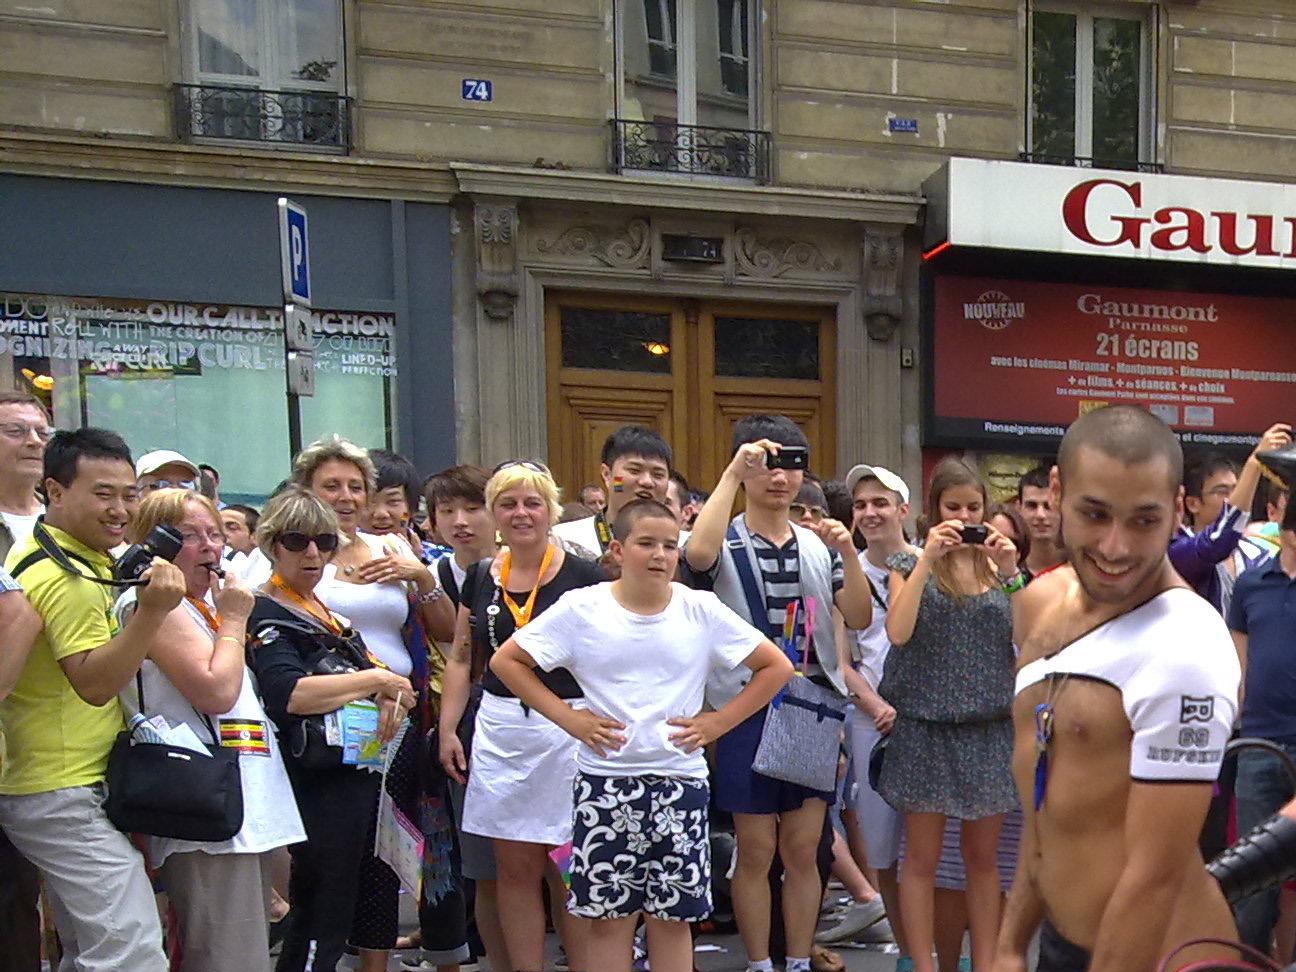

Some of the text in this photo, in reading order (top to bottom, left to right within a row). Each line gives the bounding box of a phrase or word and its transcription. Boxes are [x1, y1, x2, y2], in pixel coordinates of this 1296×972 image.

[465, 81, 488, 100] 74
[291, 224, 303, 281] P
[146, 303, 198, 326] OUR
[203, 306, 263, 329] CALL
[266, 310, 283, 329] T
[963, 302, 1025, 320] NOUVEAU
[1077, 294, 1218, 322] Gaumont
[1109, 318, 1188, 333] Parnasse
[149, 340, 195, 366] RIP
[198, 342, 266, 370] CURL
[1096, 332, 1199, 361] 21 écrans
[342, 354, 396, 367] LINED-UP
[984, 421, 1064, 436] Renseignements
